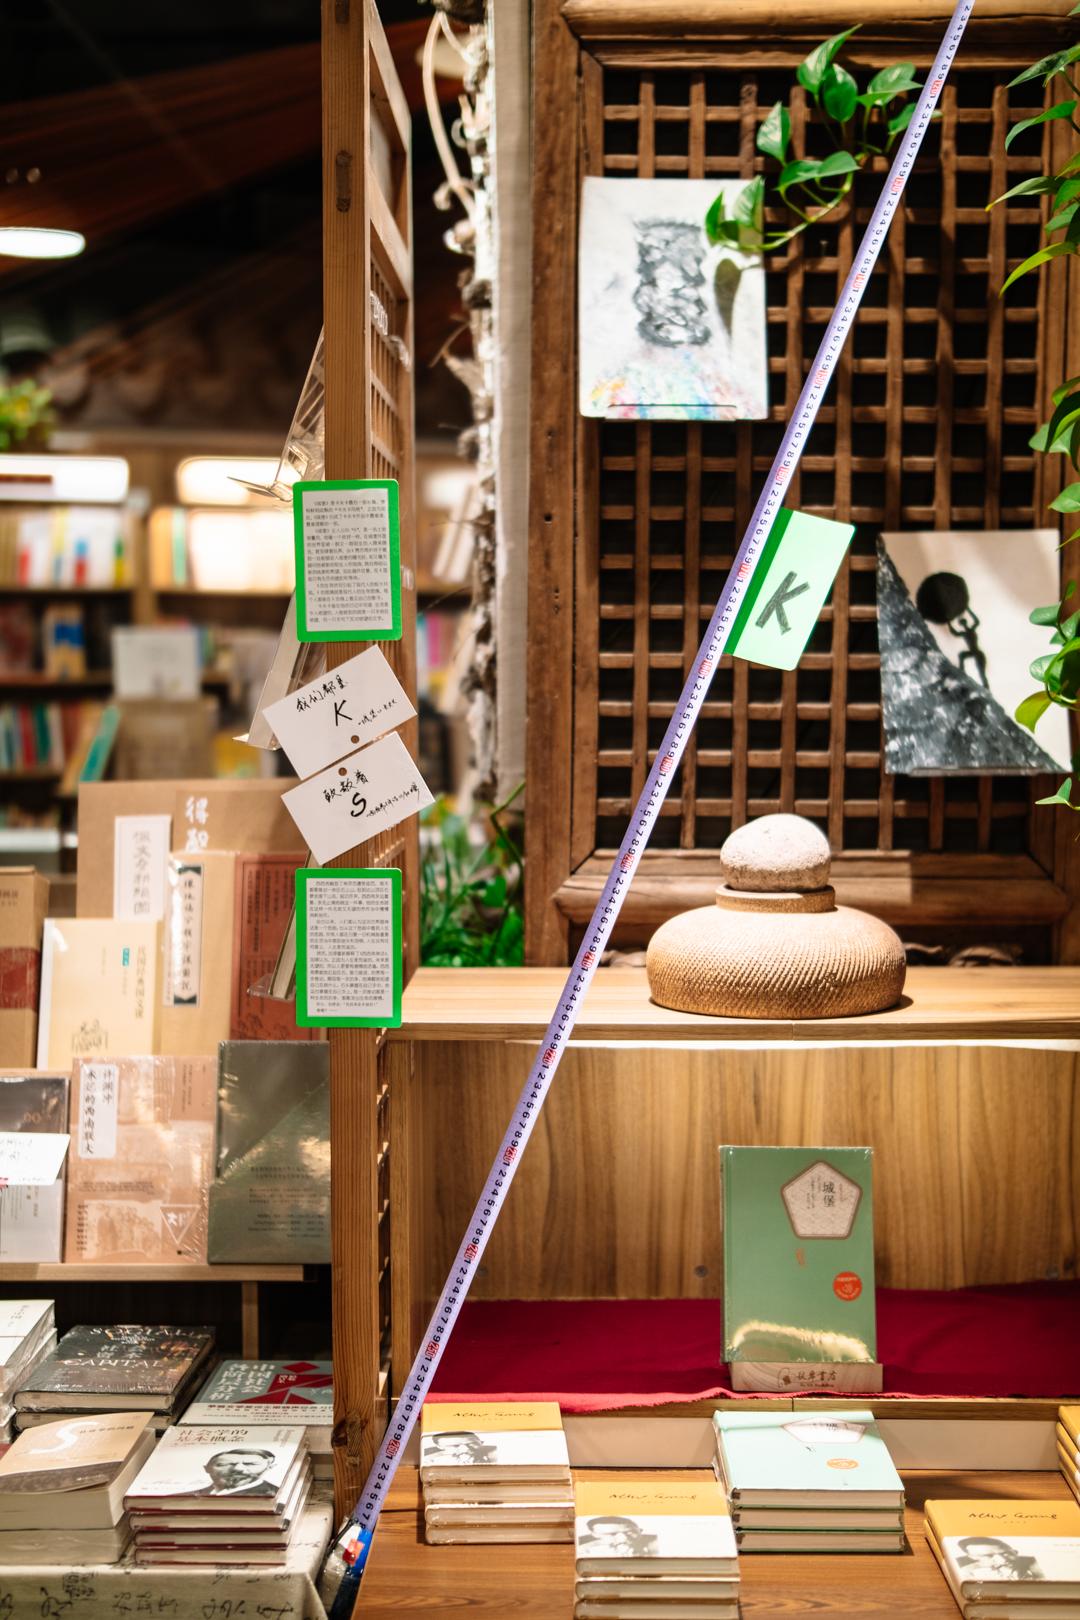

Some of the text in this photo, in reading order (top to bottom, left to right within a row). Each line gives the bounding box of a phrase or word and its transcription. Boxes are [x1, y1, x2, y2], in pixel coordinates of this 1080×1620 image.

[756, 570, 810, 636] K
[334, 700, 353, 726] K
[659, 755, 672, 772] 190
[350, 792, 367, 818] S
[620, 852, 634, 868] 200
[580, 951, 595, 967] 210
[542, 1048, 556, 1064] 220
[503, 1145, 517, 1162] 230
[822, 1181, 836, 1208] 城堡
[463, 1242, 478, 1260] 240
[424, 1340, 440, 1358] 250
[64, 1359, 164, 1368] CAPITAL
[242, 1363, 276, 1394] 中国社会
[385, 1438, 400, 1456] 260
